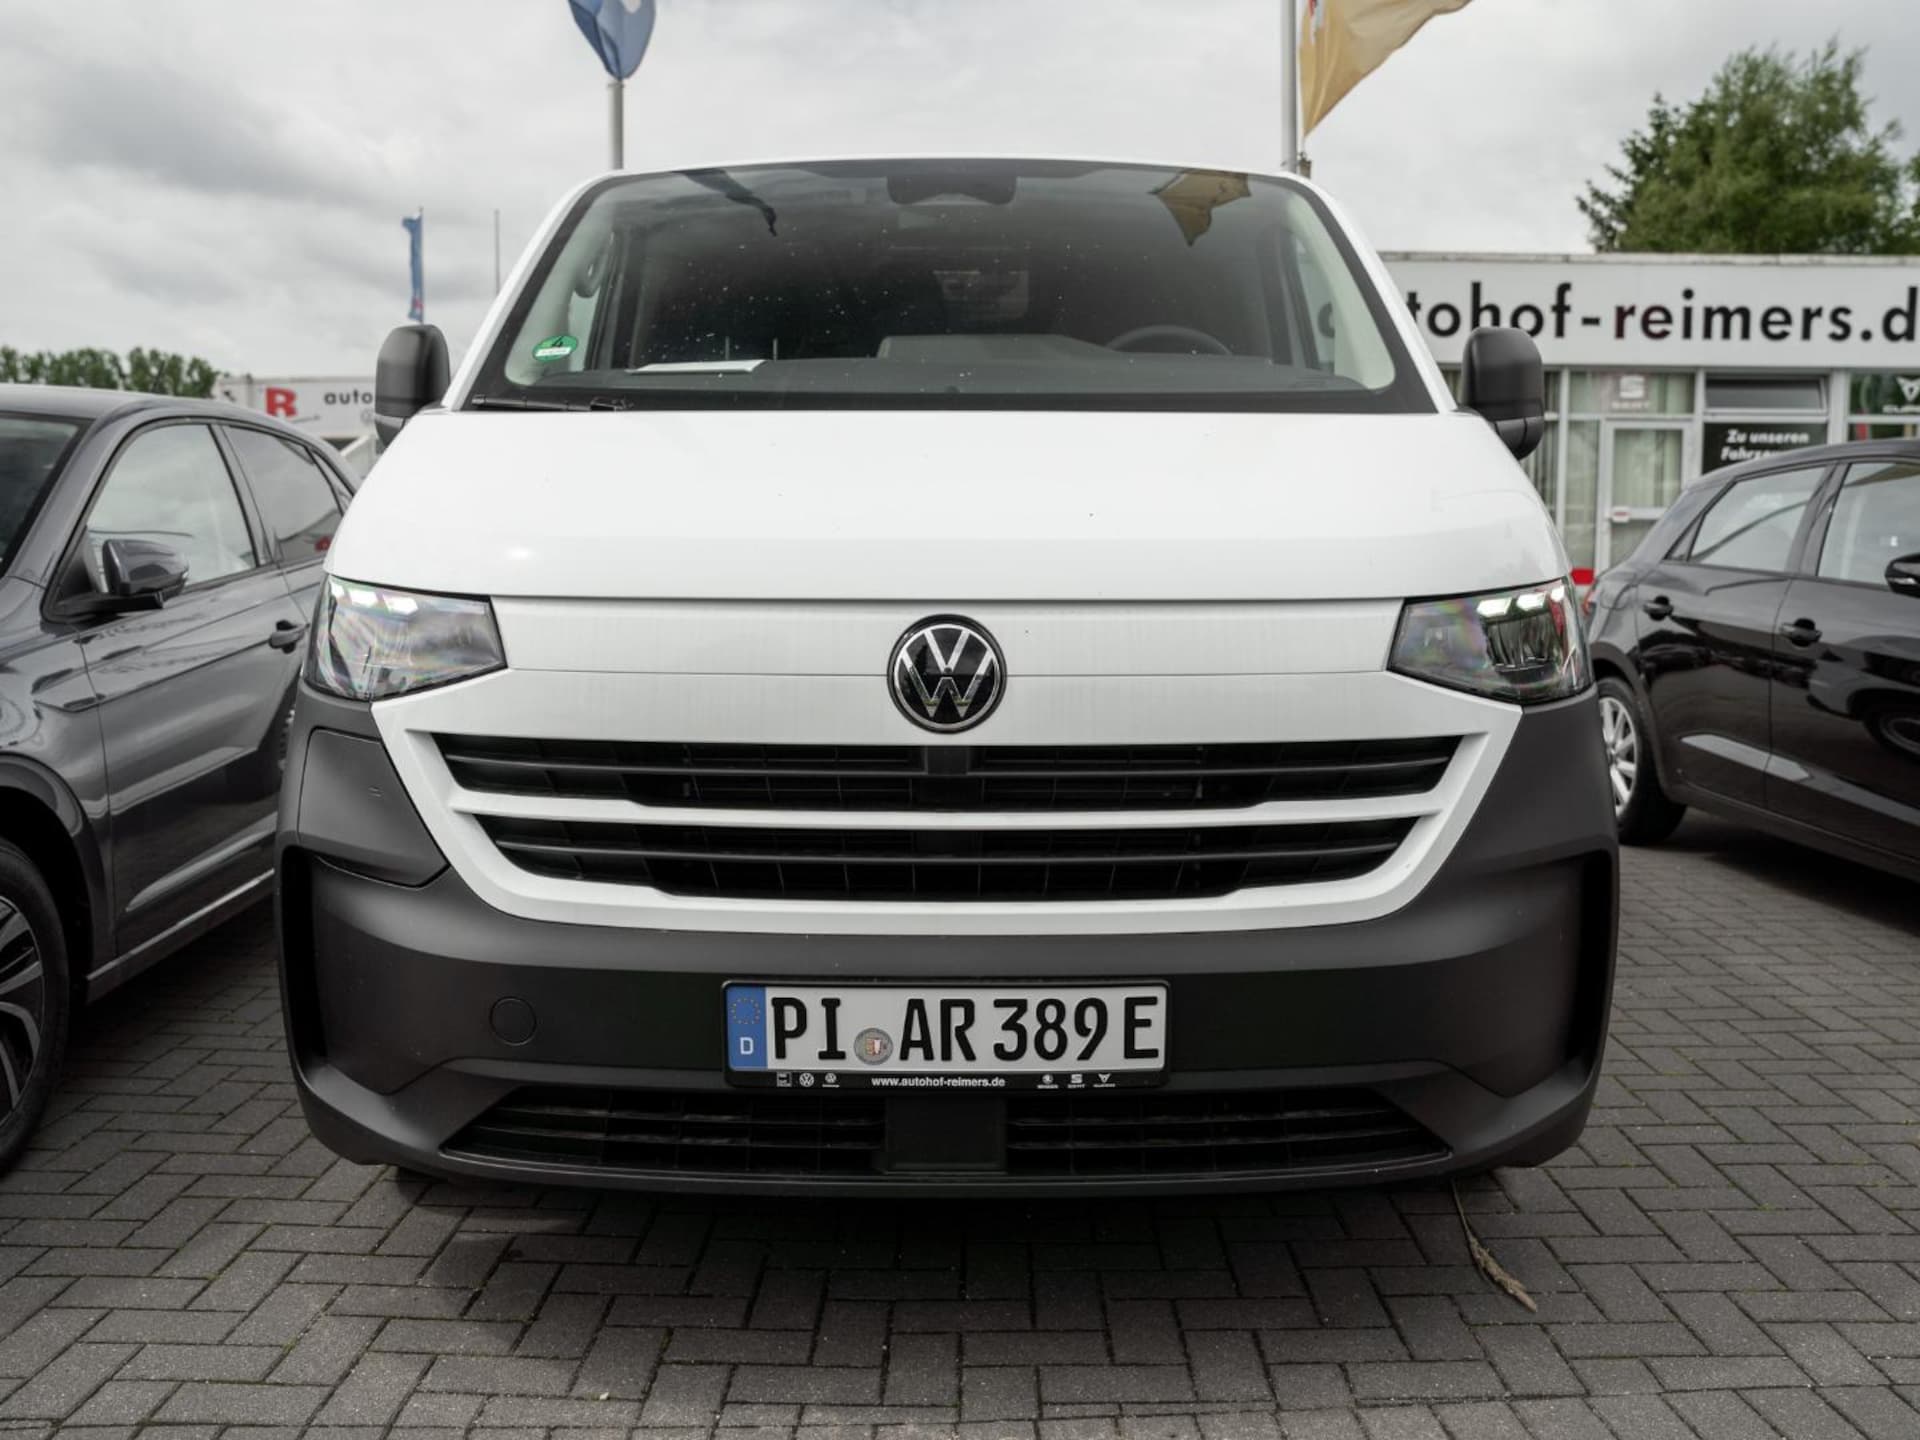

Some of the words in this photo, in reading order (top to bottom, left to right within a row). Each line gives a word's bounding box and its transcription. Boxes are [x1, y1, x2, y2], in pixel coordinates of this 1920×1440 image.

[265, 387, 297, 417] R
[1727, 429, 1747, 443] Zu
[1749, 432, 1809, 443] unseren
[740, 1036, 754, 1055] D
[771, 997, 846, 1060] PI
[898, 998, 977, 1061] AR
[871, 1077, 1006, 1087] www.autohof-reimers.de
